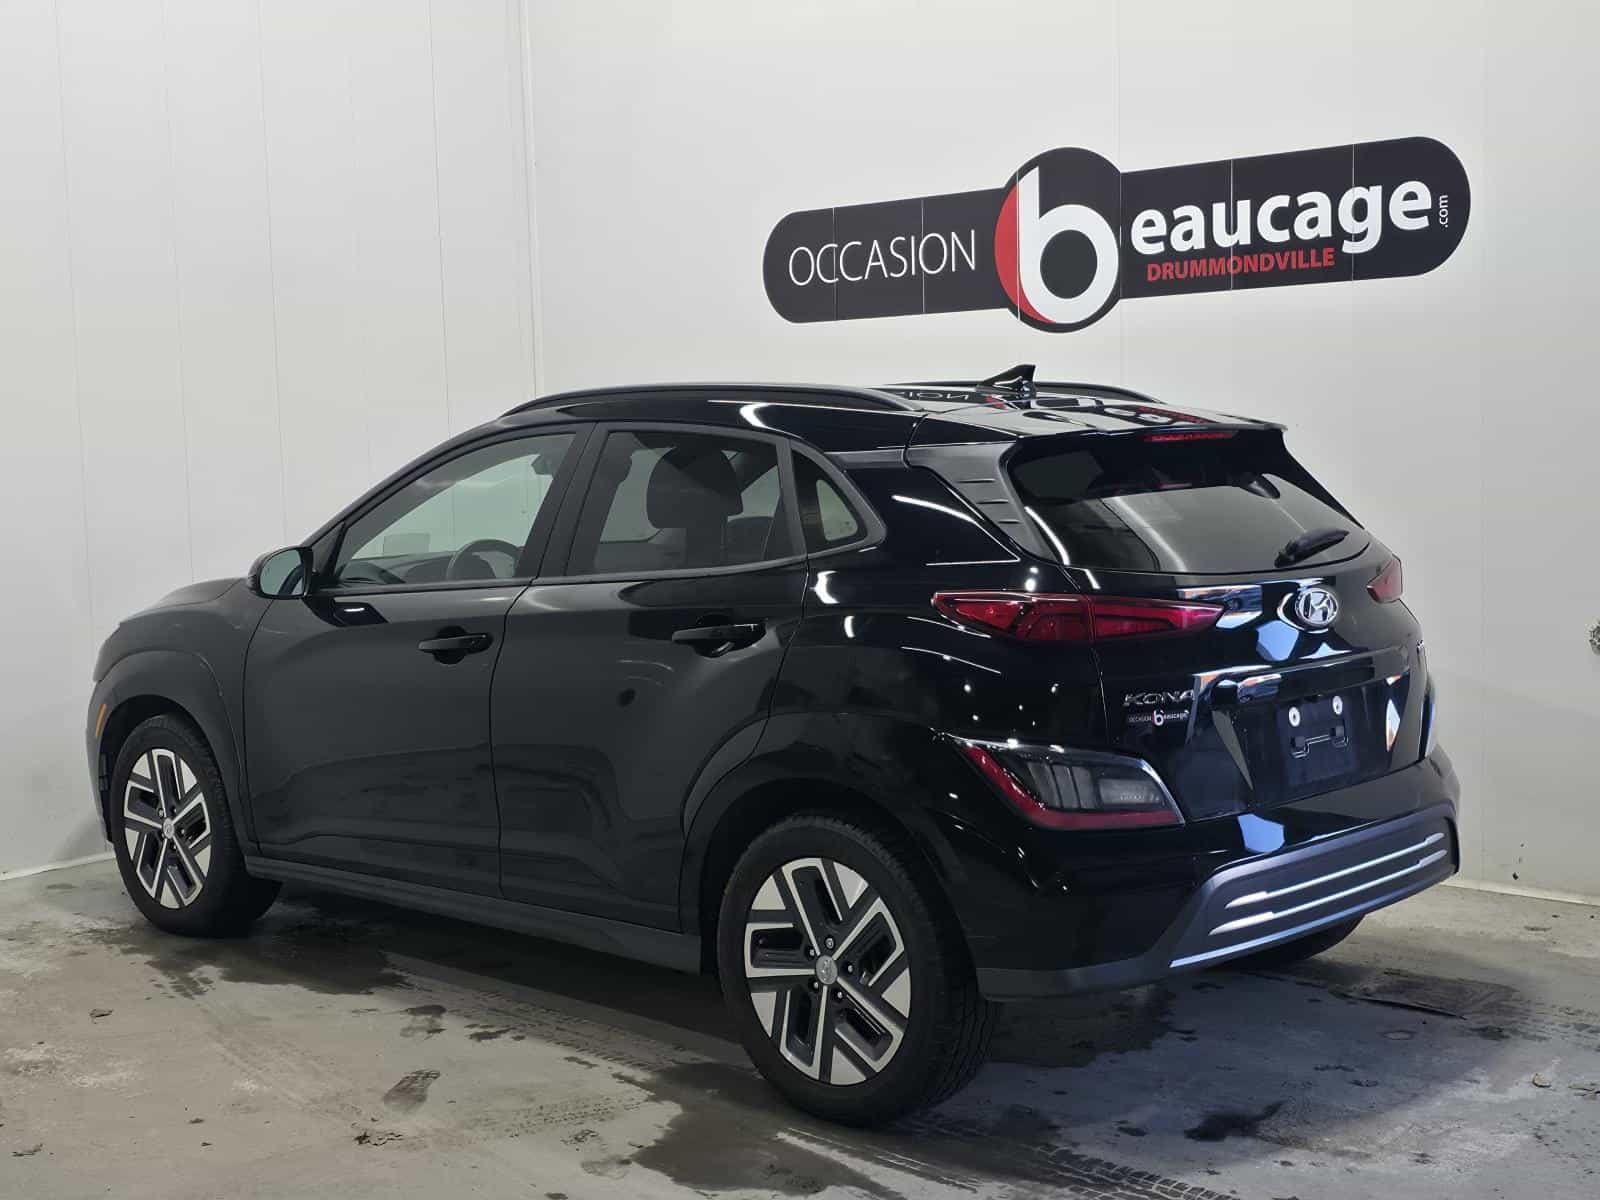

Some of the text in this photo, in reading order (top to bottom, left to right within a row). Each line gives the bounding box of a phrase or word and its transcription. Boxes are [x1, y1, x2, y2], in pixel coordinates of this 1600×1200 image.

[1438, 194, 1449, 229] .com
[788, 229, 976, 286] OCCASION
[1146, 247, 1336, 282] DRUMMONDVILLE
[1122, 689, 1195, 707] KONA
